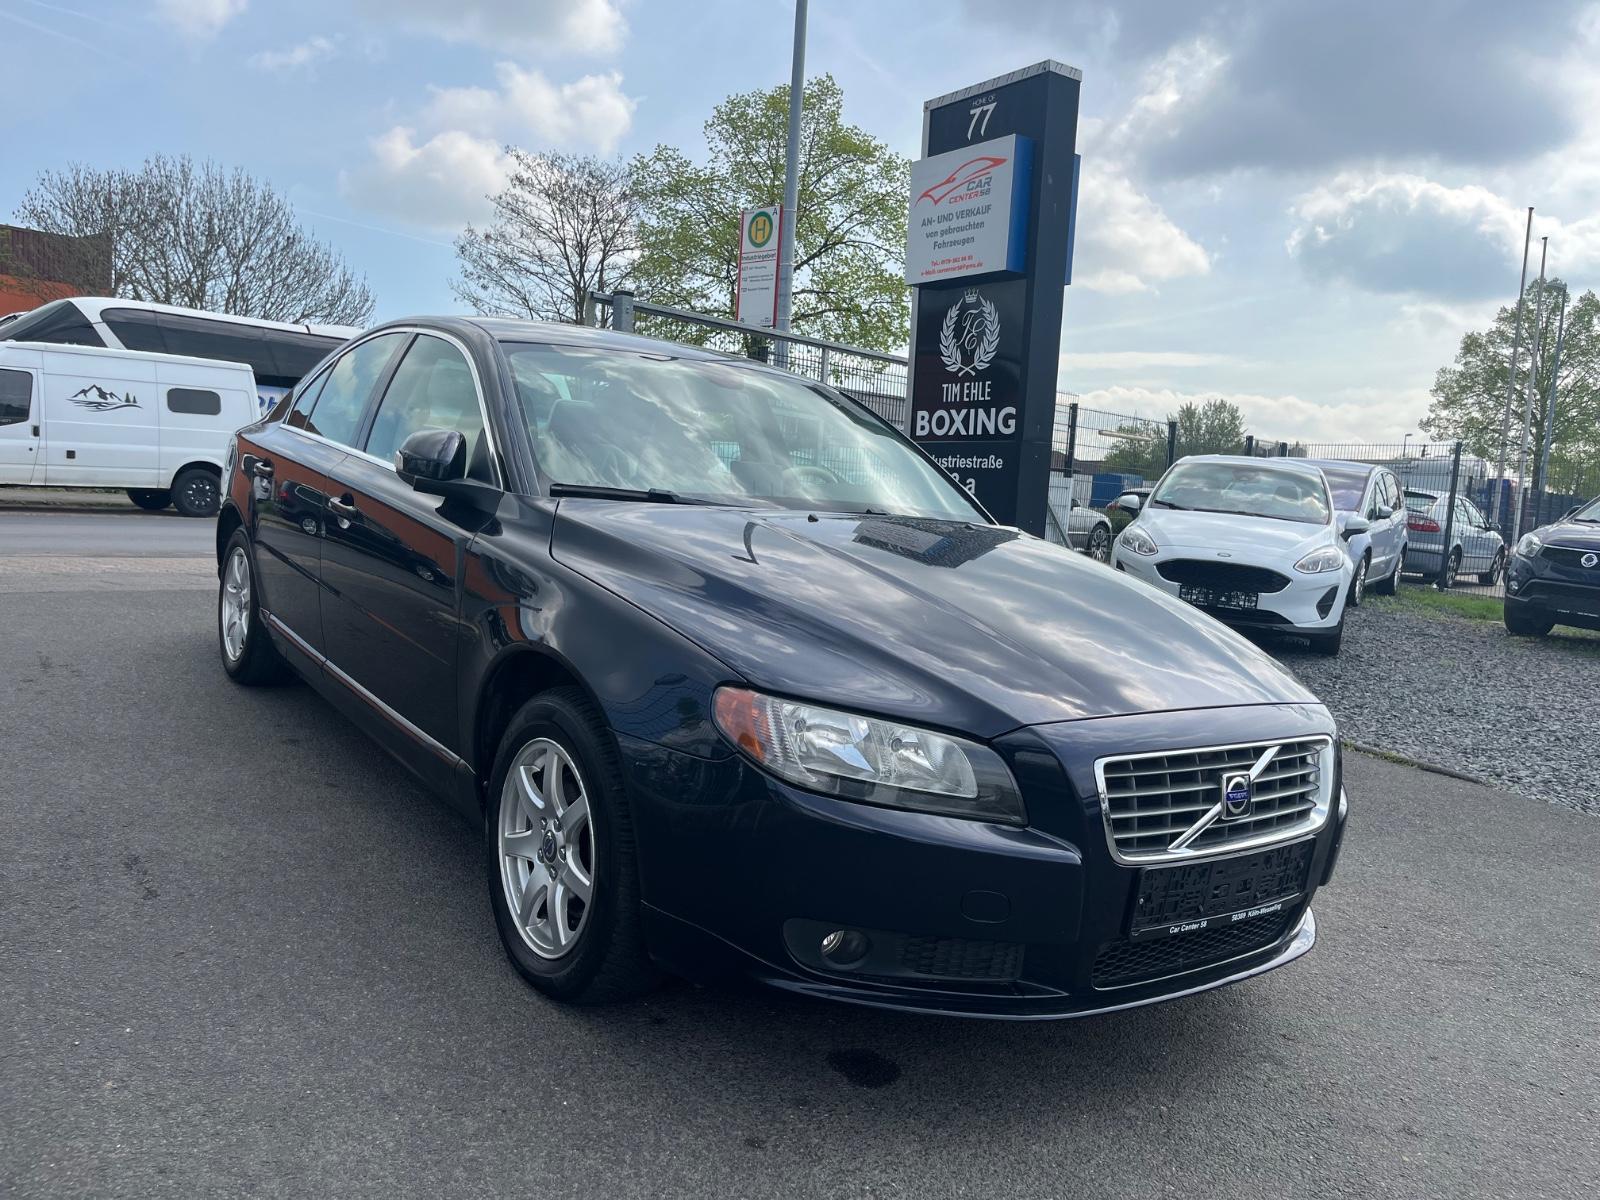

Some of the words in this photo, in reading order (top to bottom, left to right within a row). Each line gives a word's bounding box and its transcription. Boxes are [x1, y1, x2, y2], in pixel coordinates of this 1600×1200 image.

[967, 102, 998, 141] 77
[966, 176, 993, 191] CAR
[772, 207, 778, 216] A
[921, 217, 935, 228] AN-
[937, 212, 954, 224] UND
[955, 204, 992, 220] VERKAUF
[755, 219, 767, 241] H
[925, 230, 939, 239] von
[939, 221, 985, 238] gebrauchten
[933, 236, 975, 250] Fahrzeugen
[942, 383, 961, 402] TIM
[964, 381, 992, 401] EHLE
[915, 406, 1017, 436] BOXING
[932, 454, 1003, 469] ustriestraße
[1170, 926, 1180, 934] Car
[1181, 923, 1200, 932] Center
[1200, 920, 1208, 928] 58
